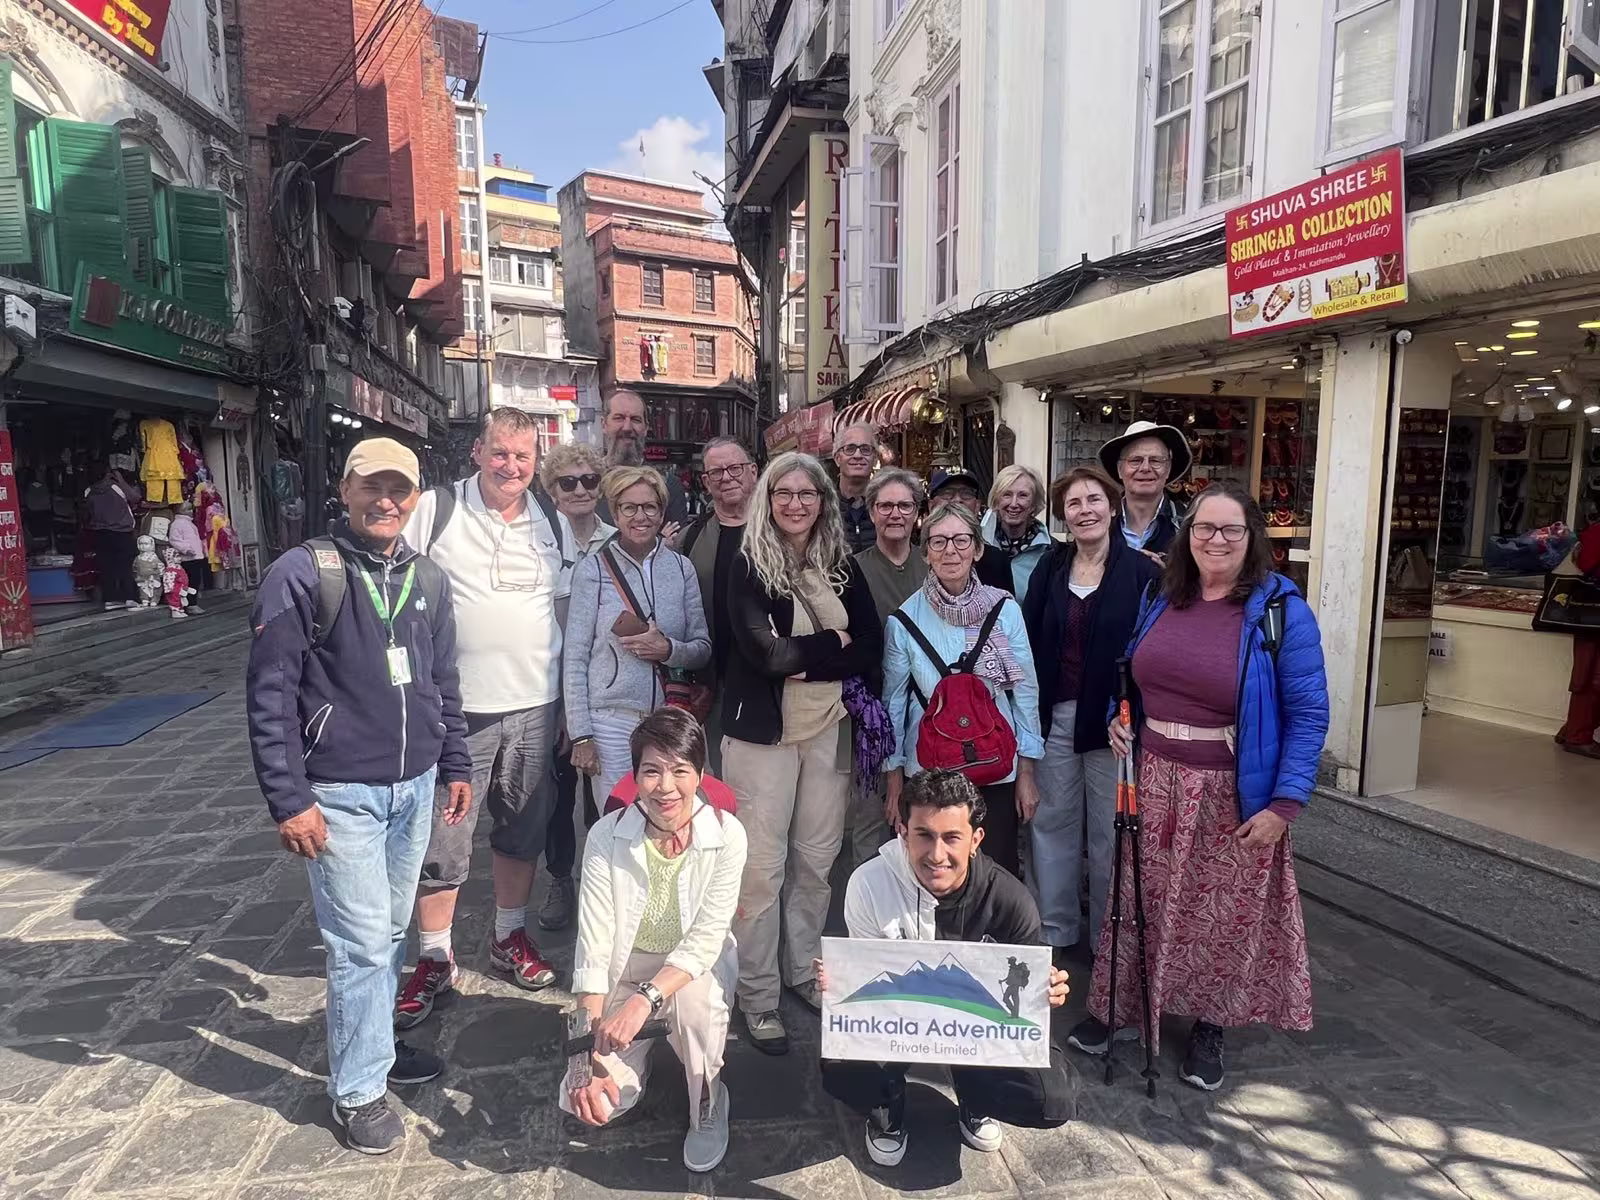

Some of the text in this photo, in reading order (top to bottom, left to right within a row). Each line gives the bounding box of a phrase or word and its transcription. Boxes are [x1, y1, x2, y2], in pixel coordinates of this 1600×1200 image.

[1251, 170, 1367, 226] SHUVA SHREE
[1231, 191, 1393, 263] SHRINGAR COLLECTION
[1234, 265, 1252, 279] Gold
[1253, 253, 1280, 271] Plated
[1284, 250, 1291, 262] &
[1344, 223, 1391, 247] Jewellery
[1309, 252, 1346, 268] Kathmandu
[1313, 290, 1397, 316] Wholesale & Retail
[816, 371, 848, 387] SARE
[1429, 648, 1446, 657] AIL
[829, 1014, 1042, 1041] Himkala Adventure
[890, 1039, 977, 1056] Private Limited
